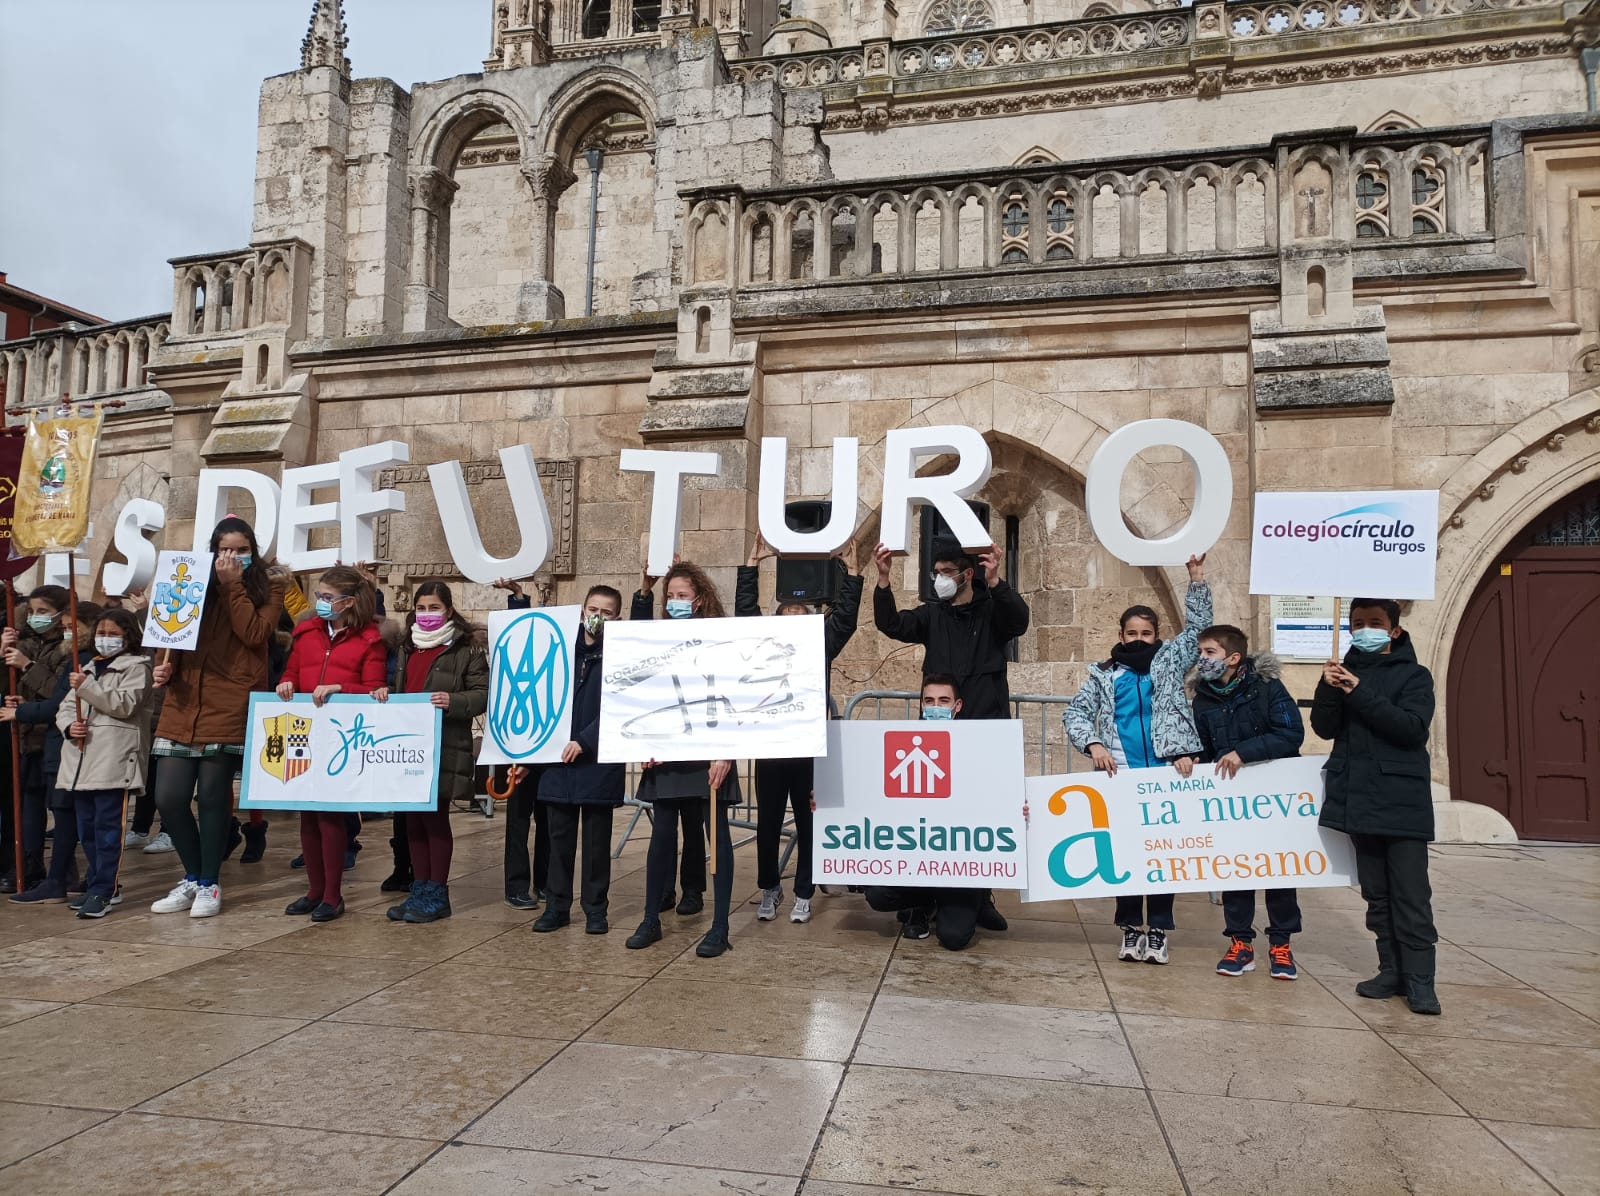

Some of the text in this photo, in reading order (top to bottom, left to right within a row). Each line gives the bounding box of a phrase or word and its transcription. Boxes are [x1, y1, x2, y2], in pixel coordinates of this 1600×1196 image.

[1262, 519, 1415, 542] colegiocírculo
[1373, 539, 1426, 555] Burgos
[1136, 775, 1216, 795] STA. MARÍA
[1198, 791, 1320, 823] nueva
[822, 816, 1018, 853] salesianos
[1144, 833, 1214, 851] SAN JOSÉ
[822, 858, 1018, 878] BURGOS P. ARAMBURU
